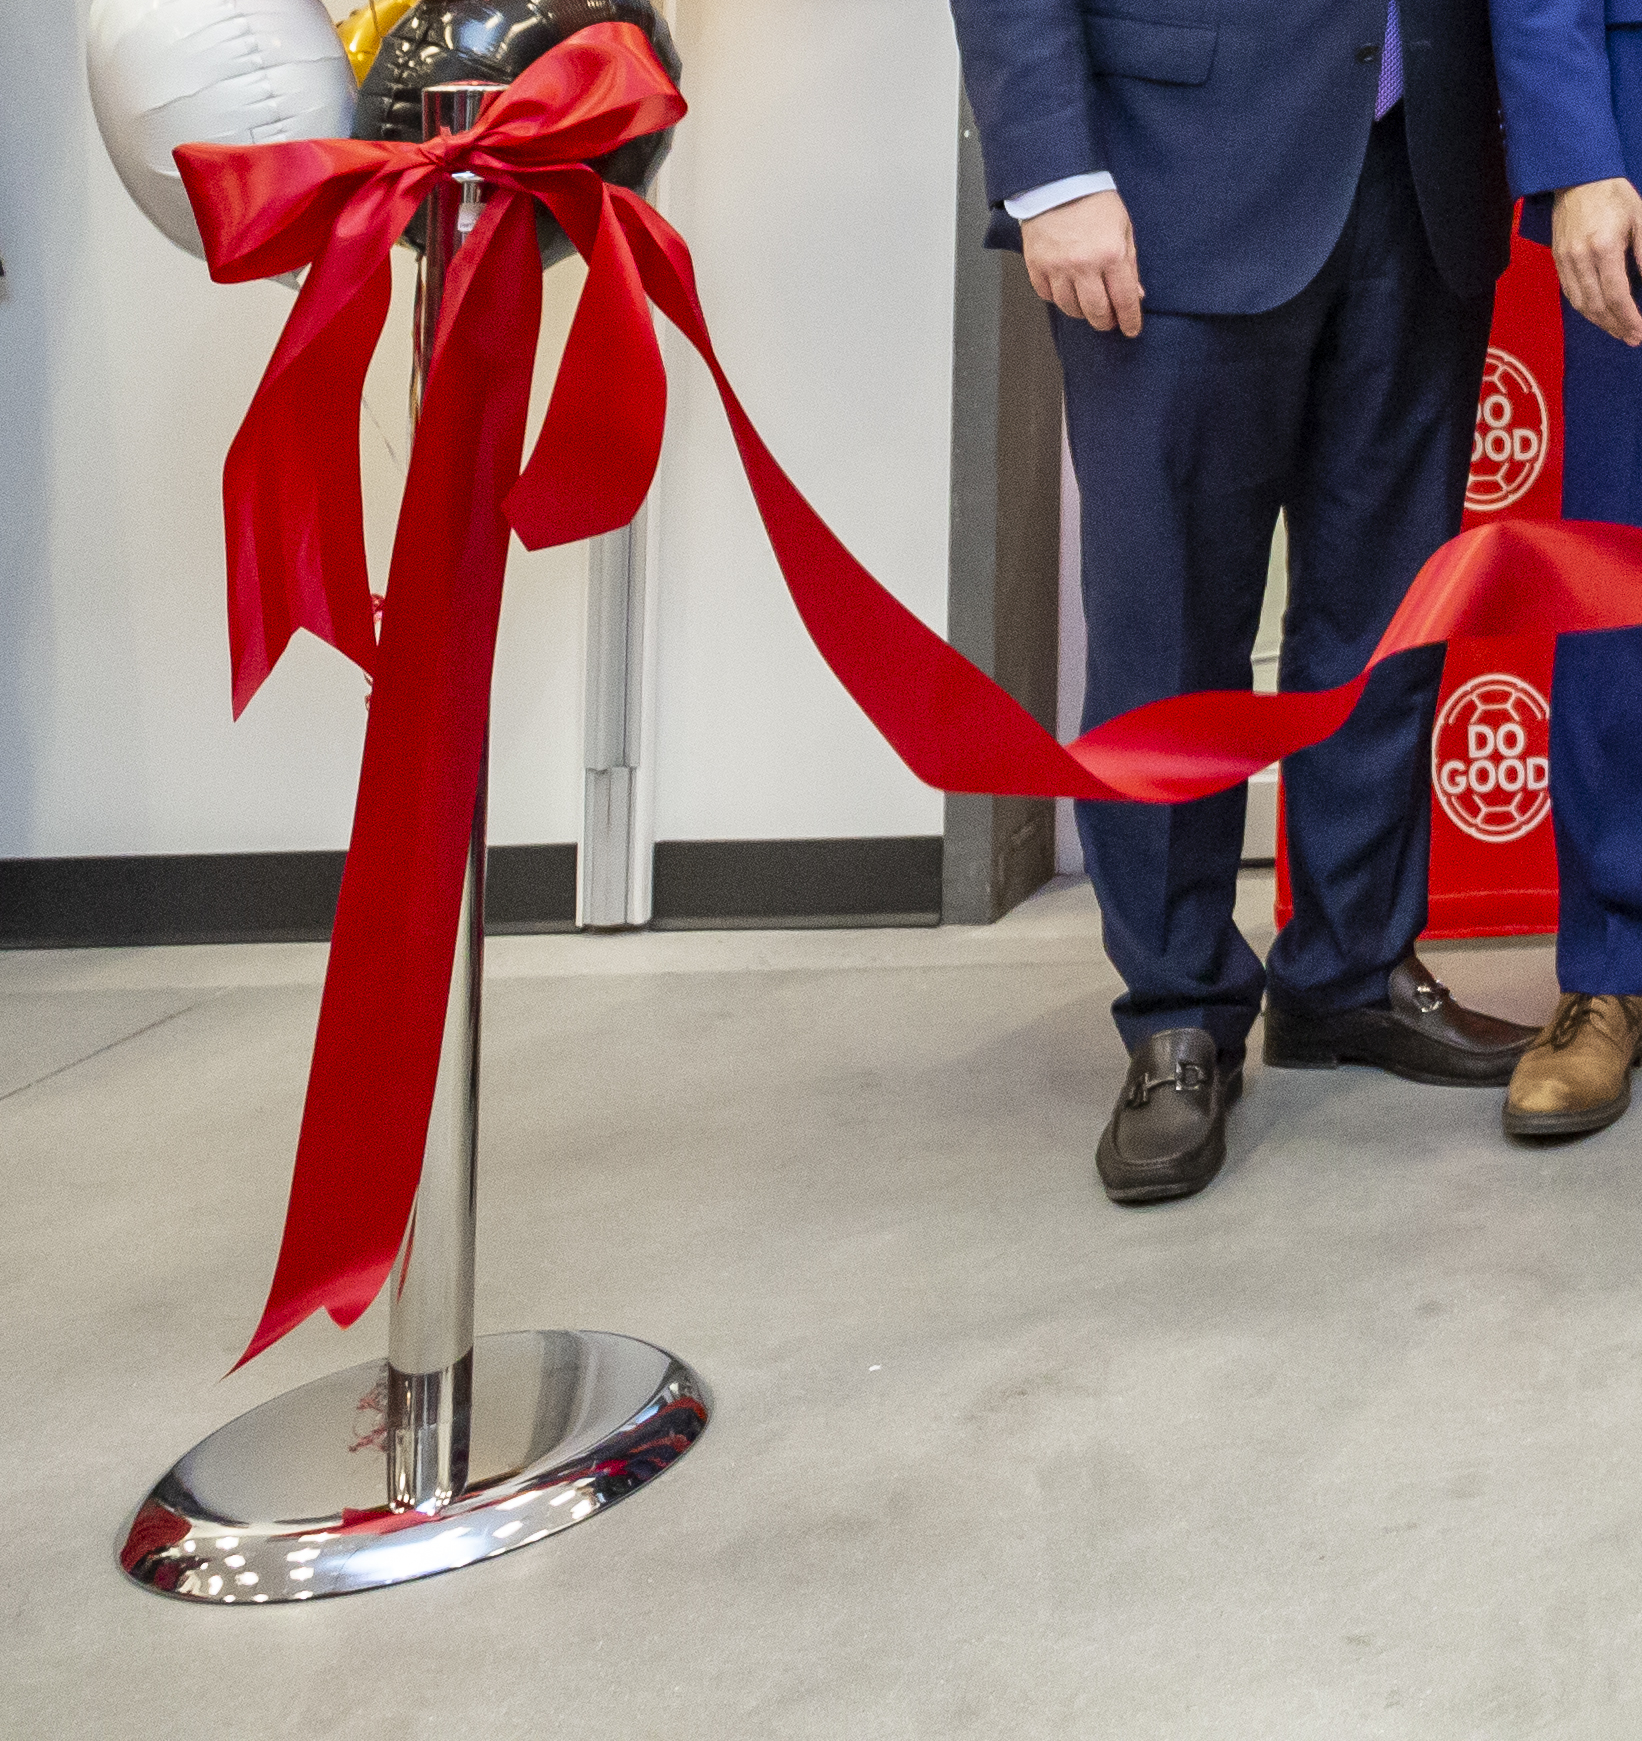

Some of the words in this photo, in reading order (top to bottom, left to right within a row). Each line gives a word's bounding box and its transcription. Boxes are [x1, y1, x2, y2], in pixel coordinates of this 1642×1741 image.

[1475, 394, 1512, 428] O
[1468, 723, 1524, 759] DO
[1440, 758, 1549, 795] GOOD
